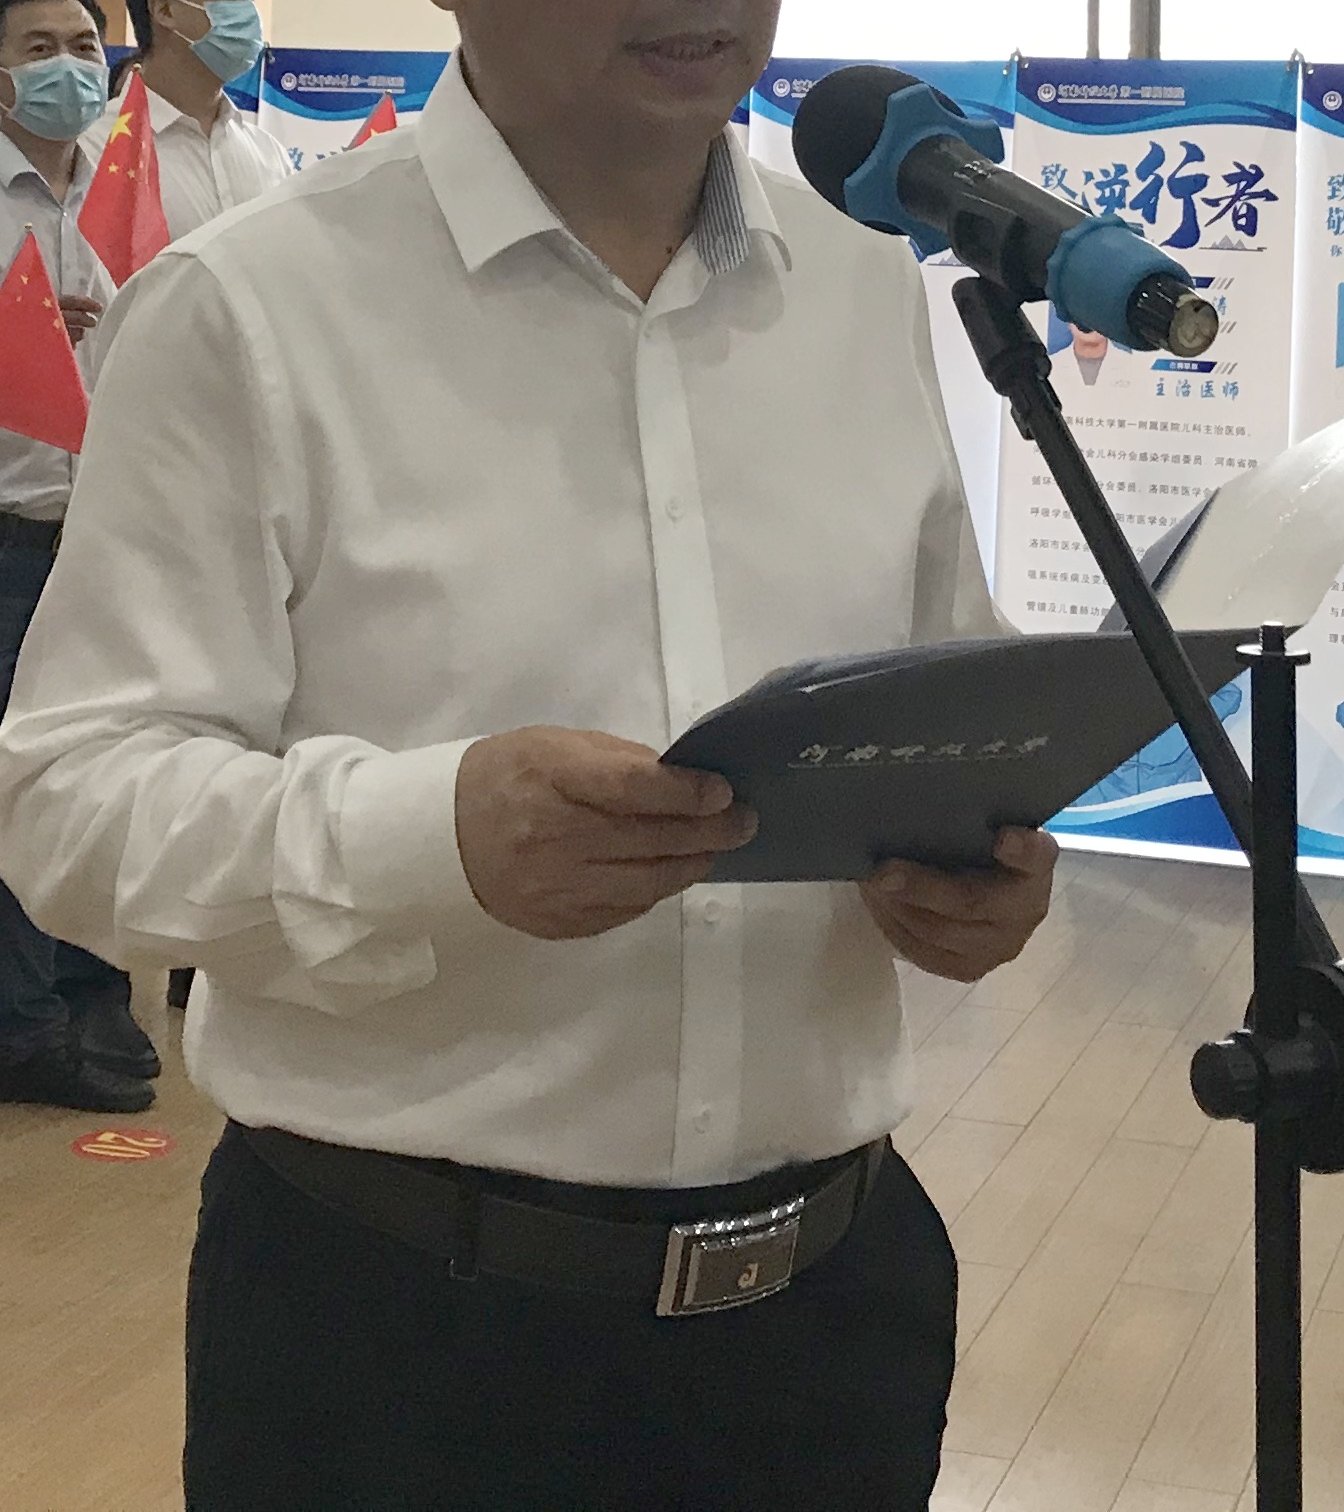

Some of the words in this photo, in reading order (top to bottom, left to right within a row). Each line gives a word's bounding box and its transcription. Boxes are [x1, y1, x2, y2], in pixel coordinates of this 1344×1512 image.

[1155, 377, 1240, 402] 主治医师
[81, 1131, 168, 1160] 20
